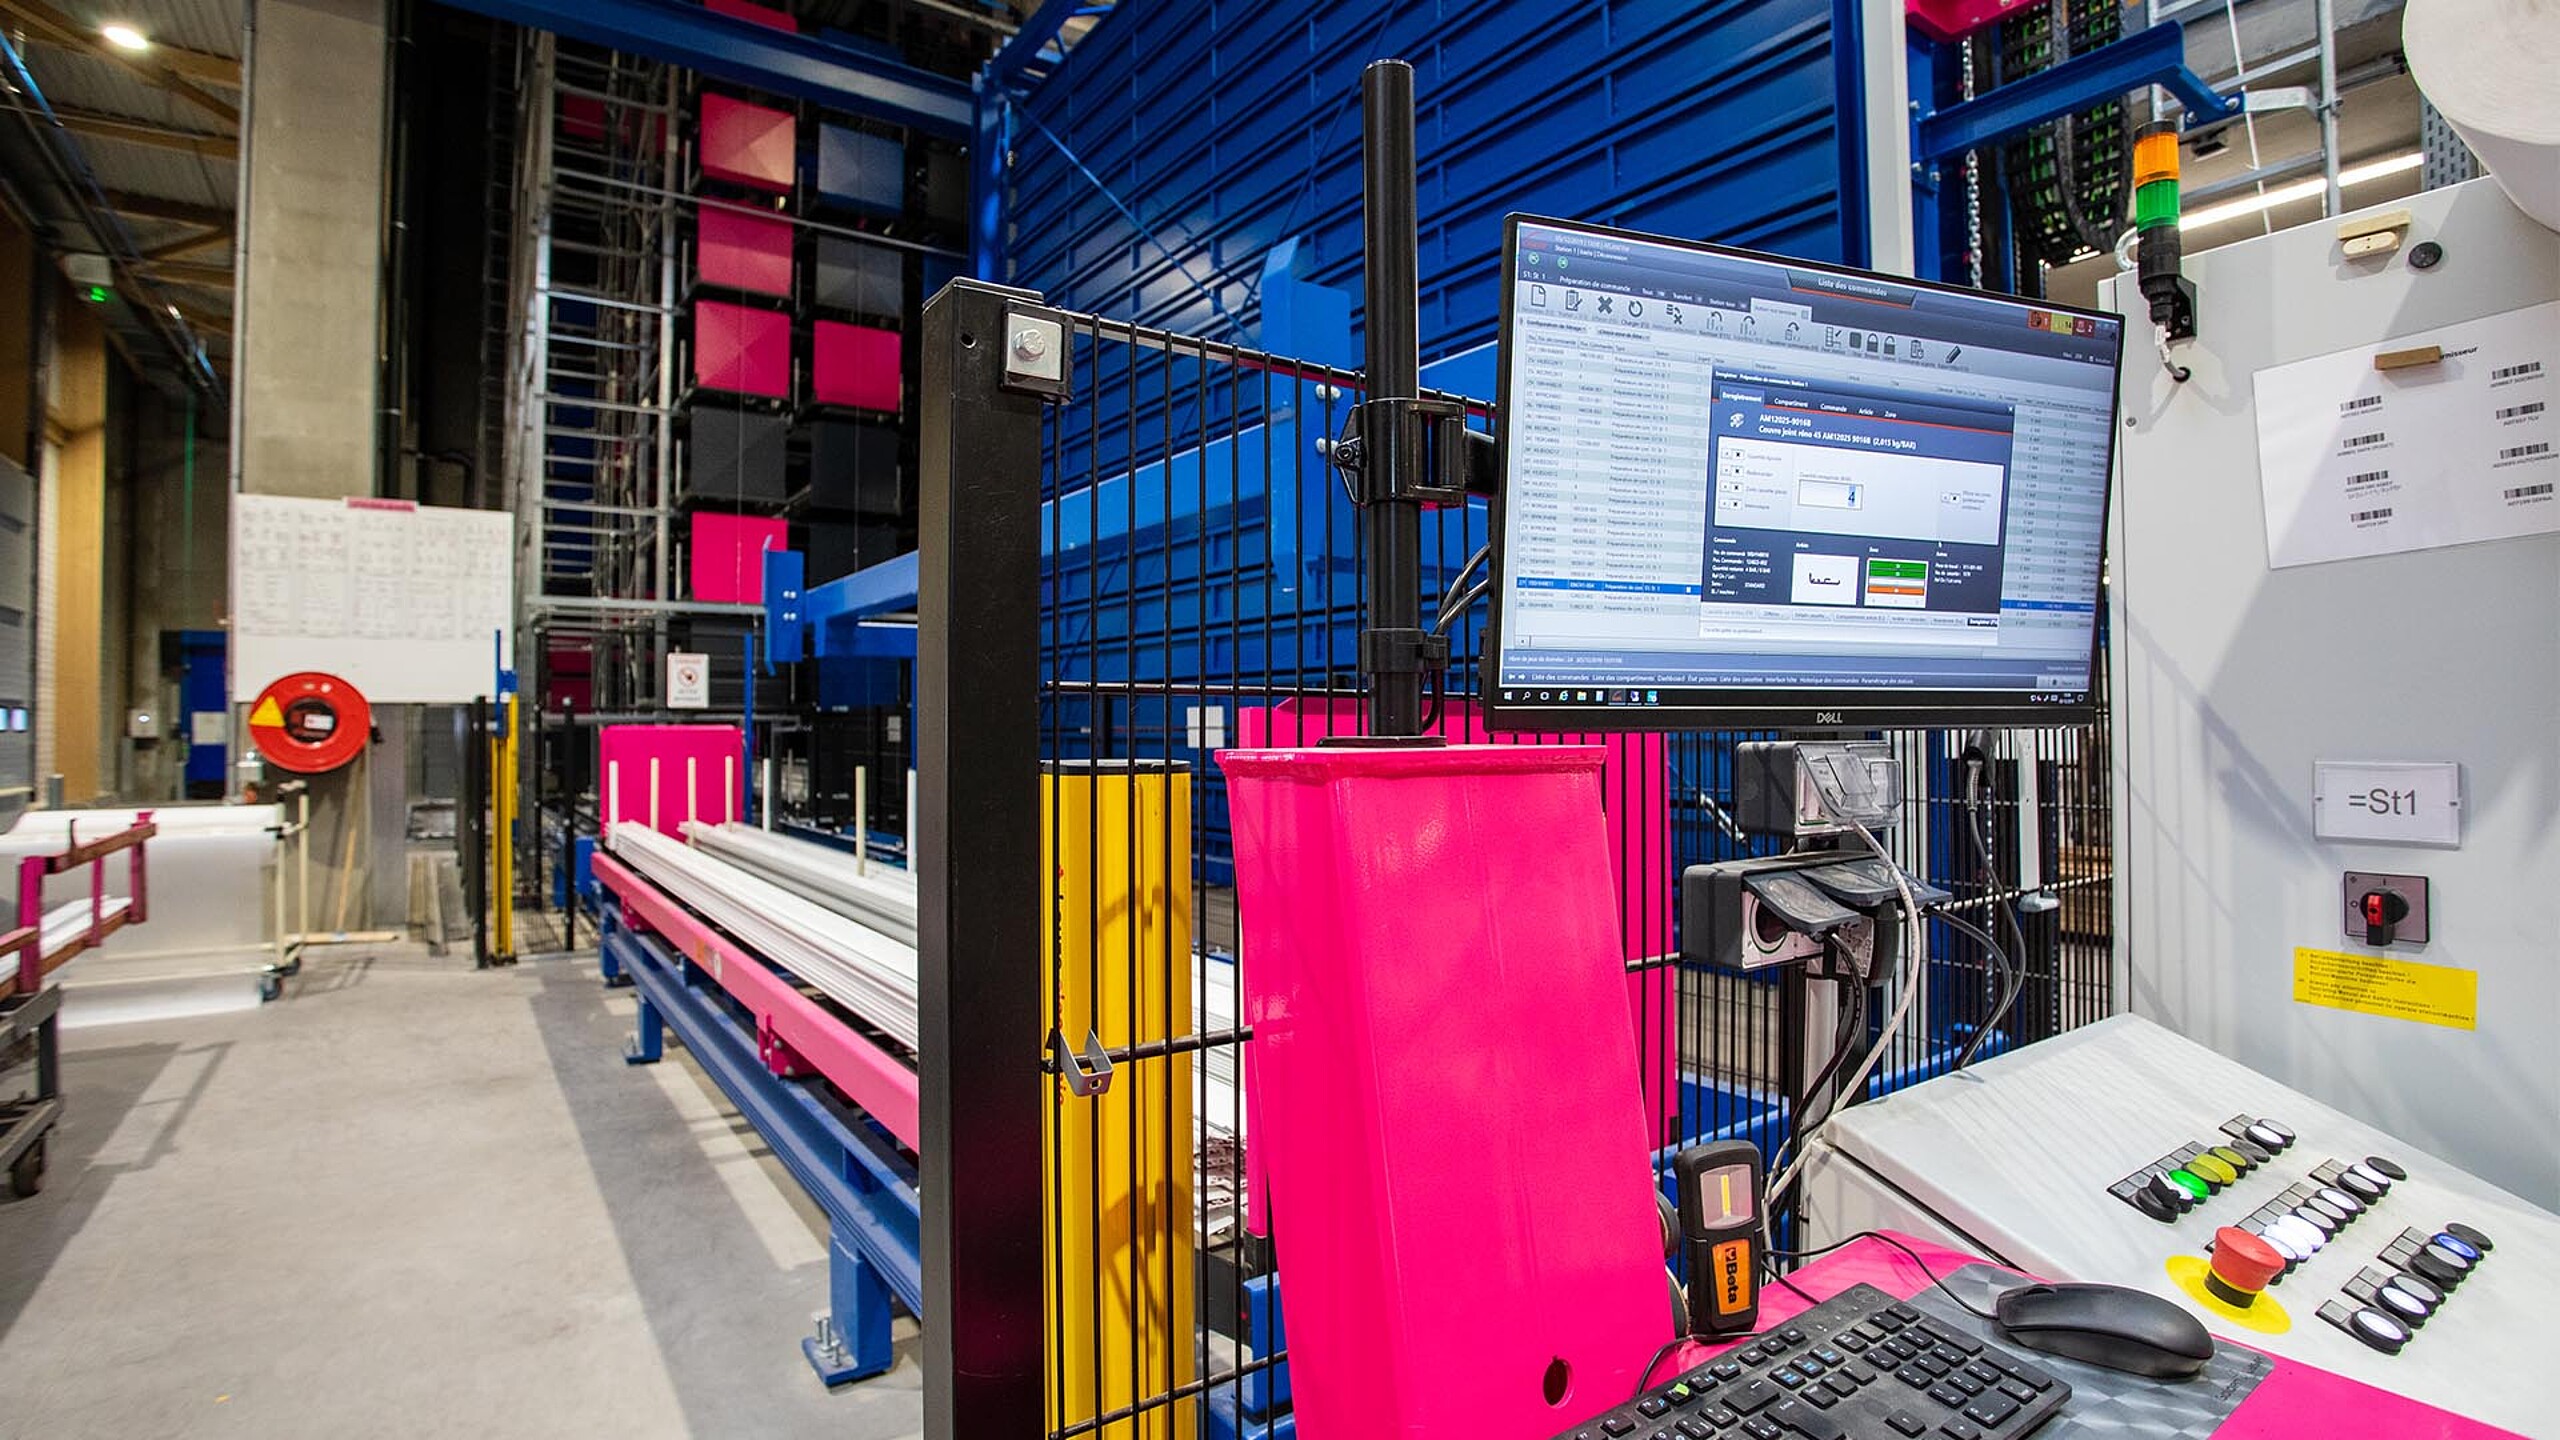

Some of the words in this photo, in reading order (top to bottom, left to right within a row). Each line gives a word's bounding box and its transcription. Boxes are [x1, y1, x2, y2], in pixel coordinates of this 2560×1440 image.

[1818, 277, 1834, 288] Liste
[1835, 279, 1848, 290] des
[1848, 283, 1888, 296] commandes
[1816, 712, 1844, 725] DELL
[2348, 788, 2418, 816] =St1
[1724, 1262, 1738, 1304] Beta
